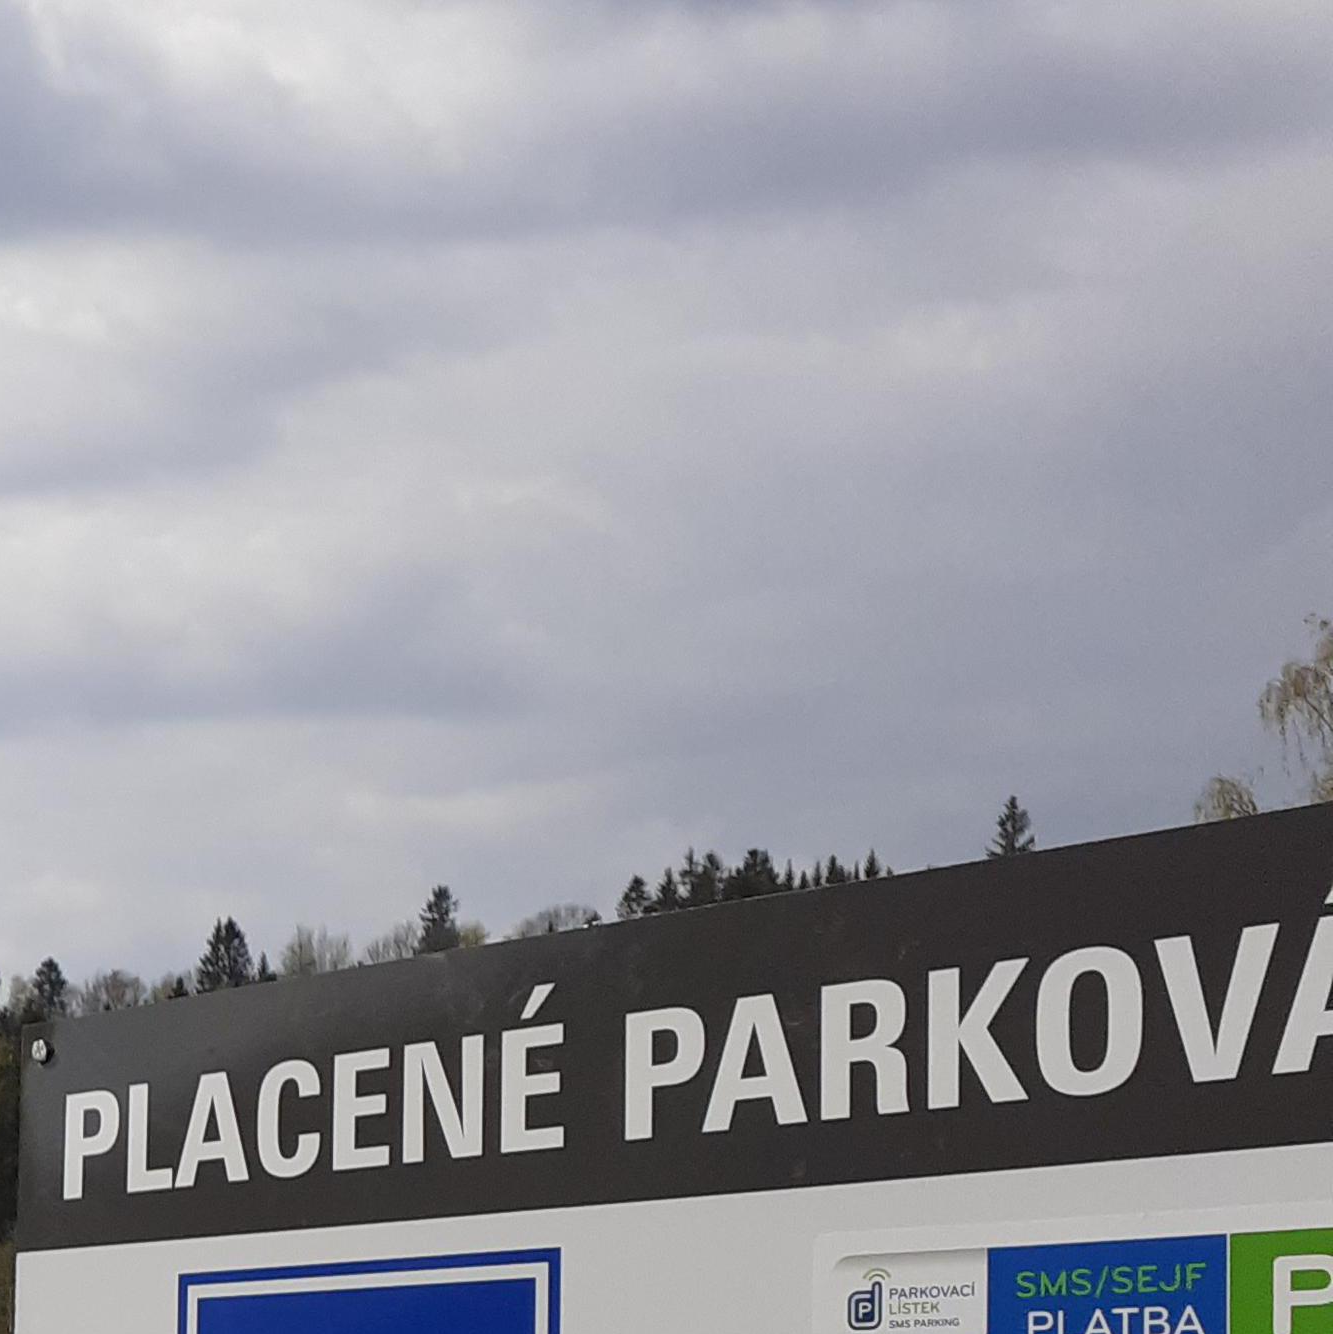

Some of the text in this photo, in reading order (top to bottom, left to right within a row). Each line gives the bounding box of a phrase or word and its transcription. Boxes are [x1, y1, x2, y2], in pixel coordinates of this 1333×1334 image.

[61, 984, 565, 1200] PLACENÉ
[1016, 1263, 1206, 1298] SMS/SEJF
[889, 1282, 975, 1299] PARKOVACÍ
[888, 1301, 940, 1315] LÍSTEK
[889, 1318, 960, 1329] SMS PARKING
